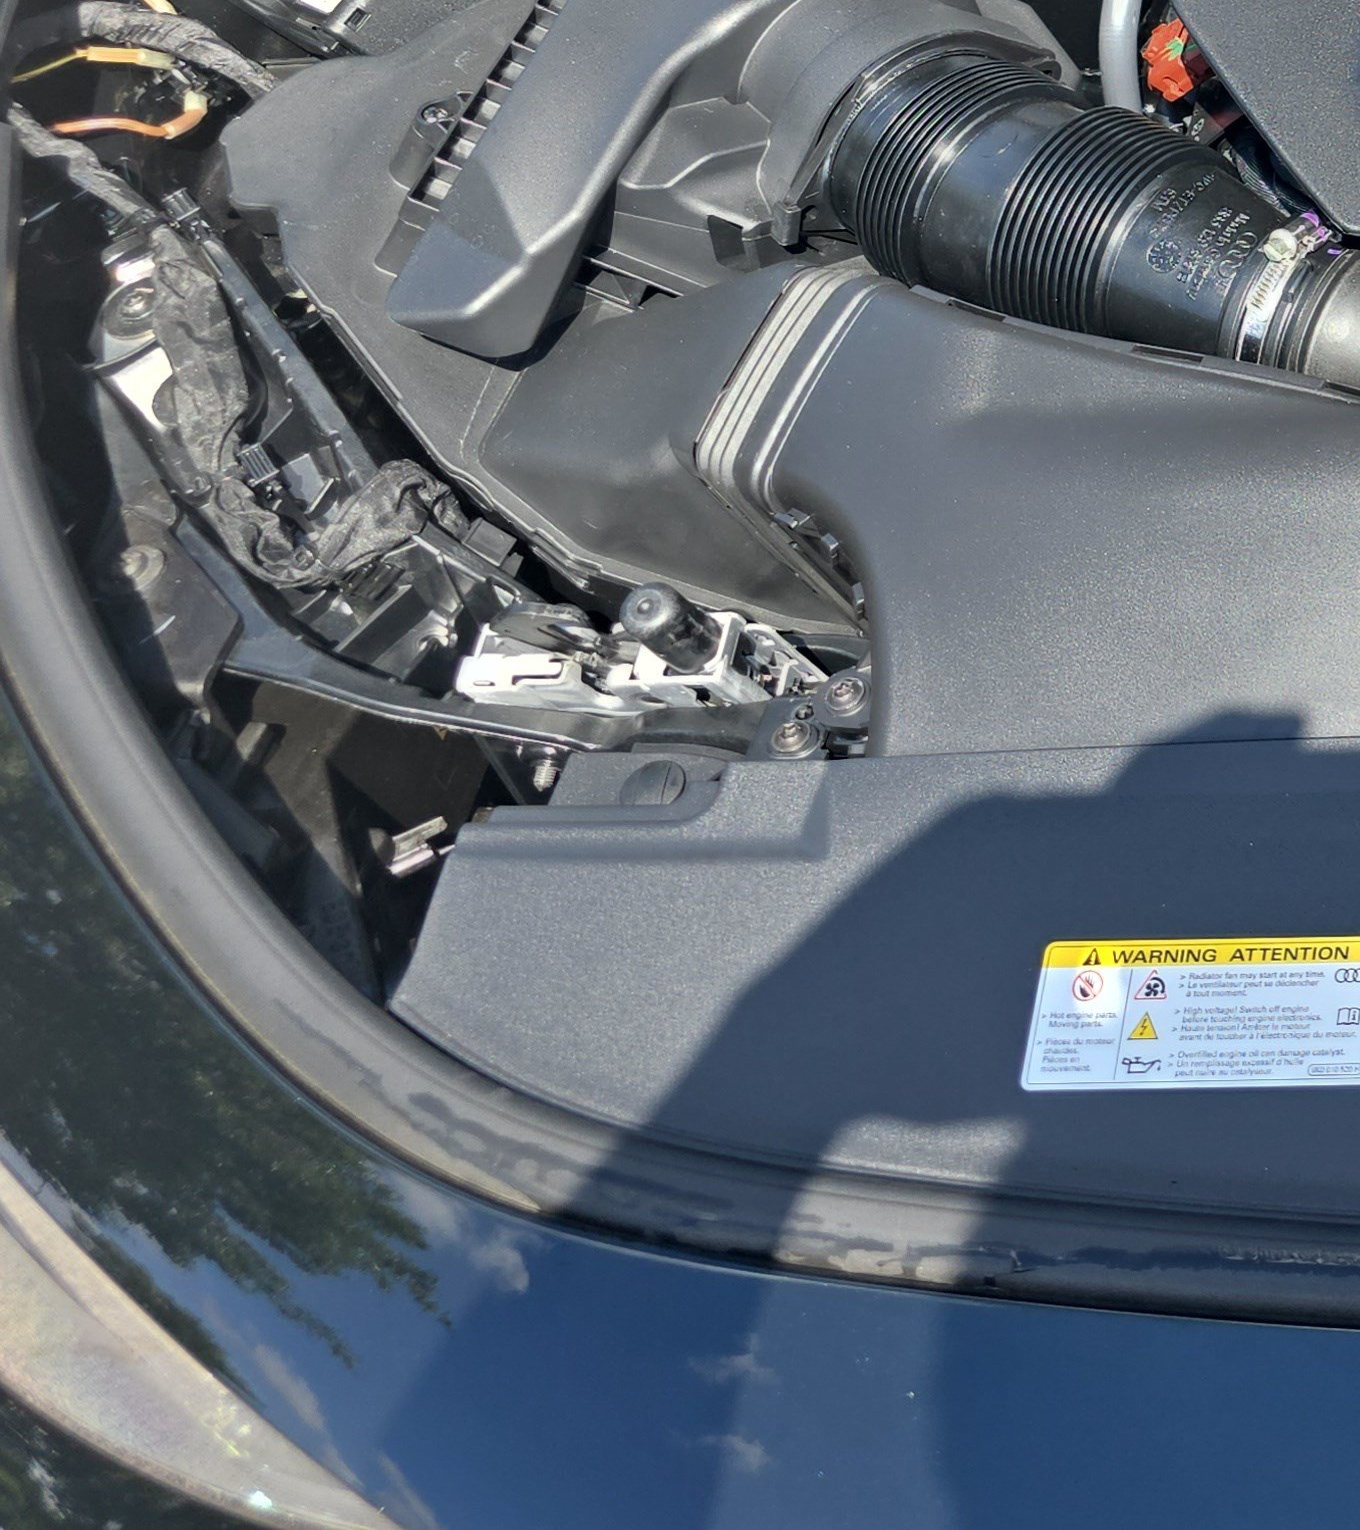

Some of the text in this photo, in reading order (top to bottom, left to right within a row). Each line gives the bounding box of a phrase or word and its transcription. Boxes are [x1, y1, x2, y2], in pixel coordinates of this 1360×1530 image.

[1113, 946, 1350, 965] WARNING ATTENTION
[1189, 972, 1222, 980] Radiator
[1224, 972, 1238, 980] fan
[1240, 973, 1256, 981] may
[1289, 972, 1303, 980] any
[1184, 1007, 1202, 1016] High
[1239, 1006, 1267, 1014] Switch
[1269, 1005, 1281, 1013] off
[1282, 1005, 1310, 1014] engine
[1050, 1011, 1065, 1019] Hot
[1066, 1012, 1093, 1020] engine
[1182, 1015, 1208, 1023] before
[1210, 1015, 1245, 1024] touching
[1247, 1015, 1275, 1023] engine
[1048, 1020, 1080, 1029] Moving
